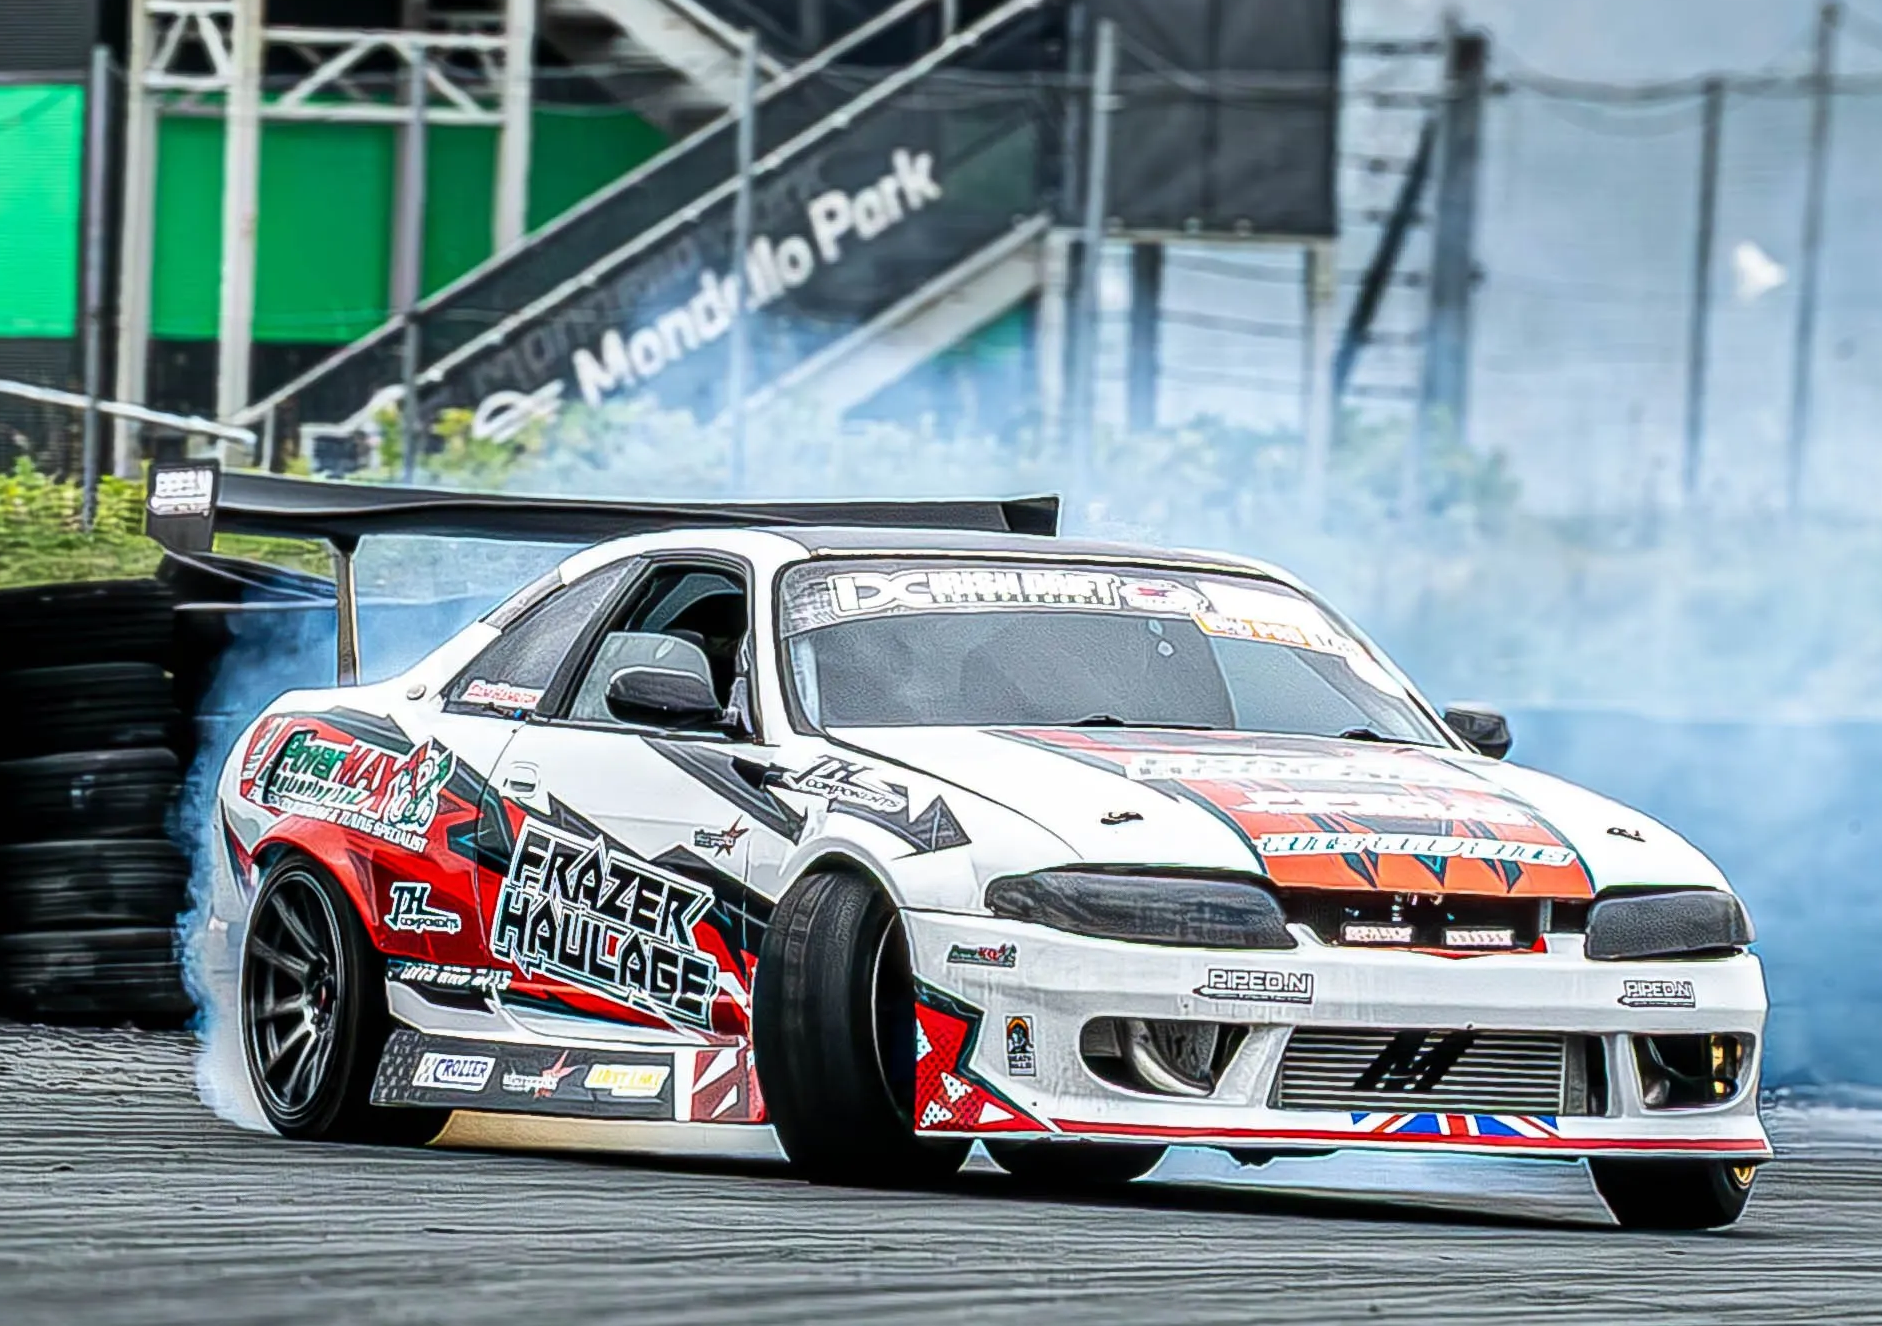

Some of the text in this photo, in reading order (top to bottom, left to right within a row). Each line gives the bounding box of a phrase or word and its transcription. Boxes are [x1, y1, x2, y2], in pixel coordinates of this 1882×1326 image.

[809, 148, 943, 263] Park
[372, 822, 430, 853] SPECIALIST
[509, 823, 713, 950] FRAZER
[492, 882, 719, 1025] HAULAGE
